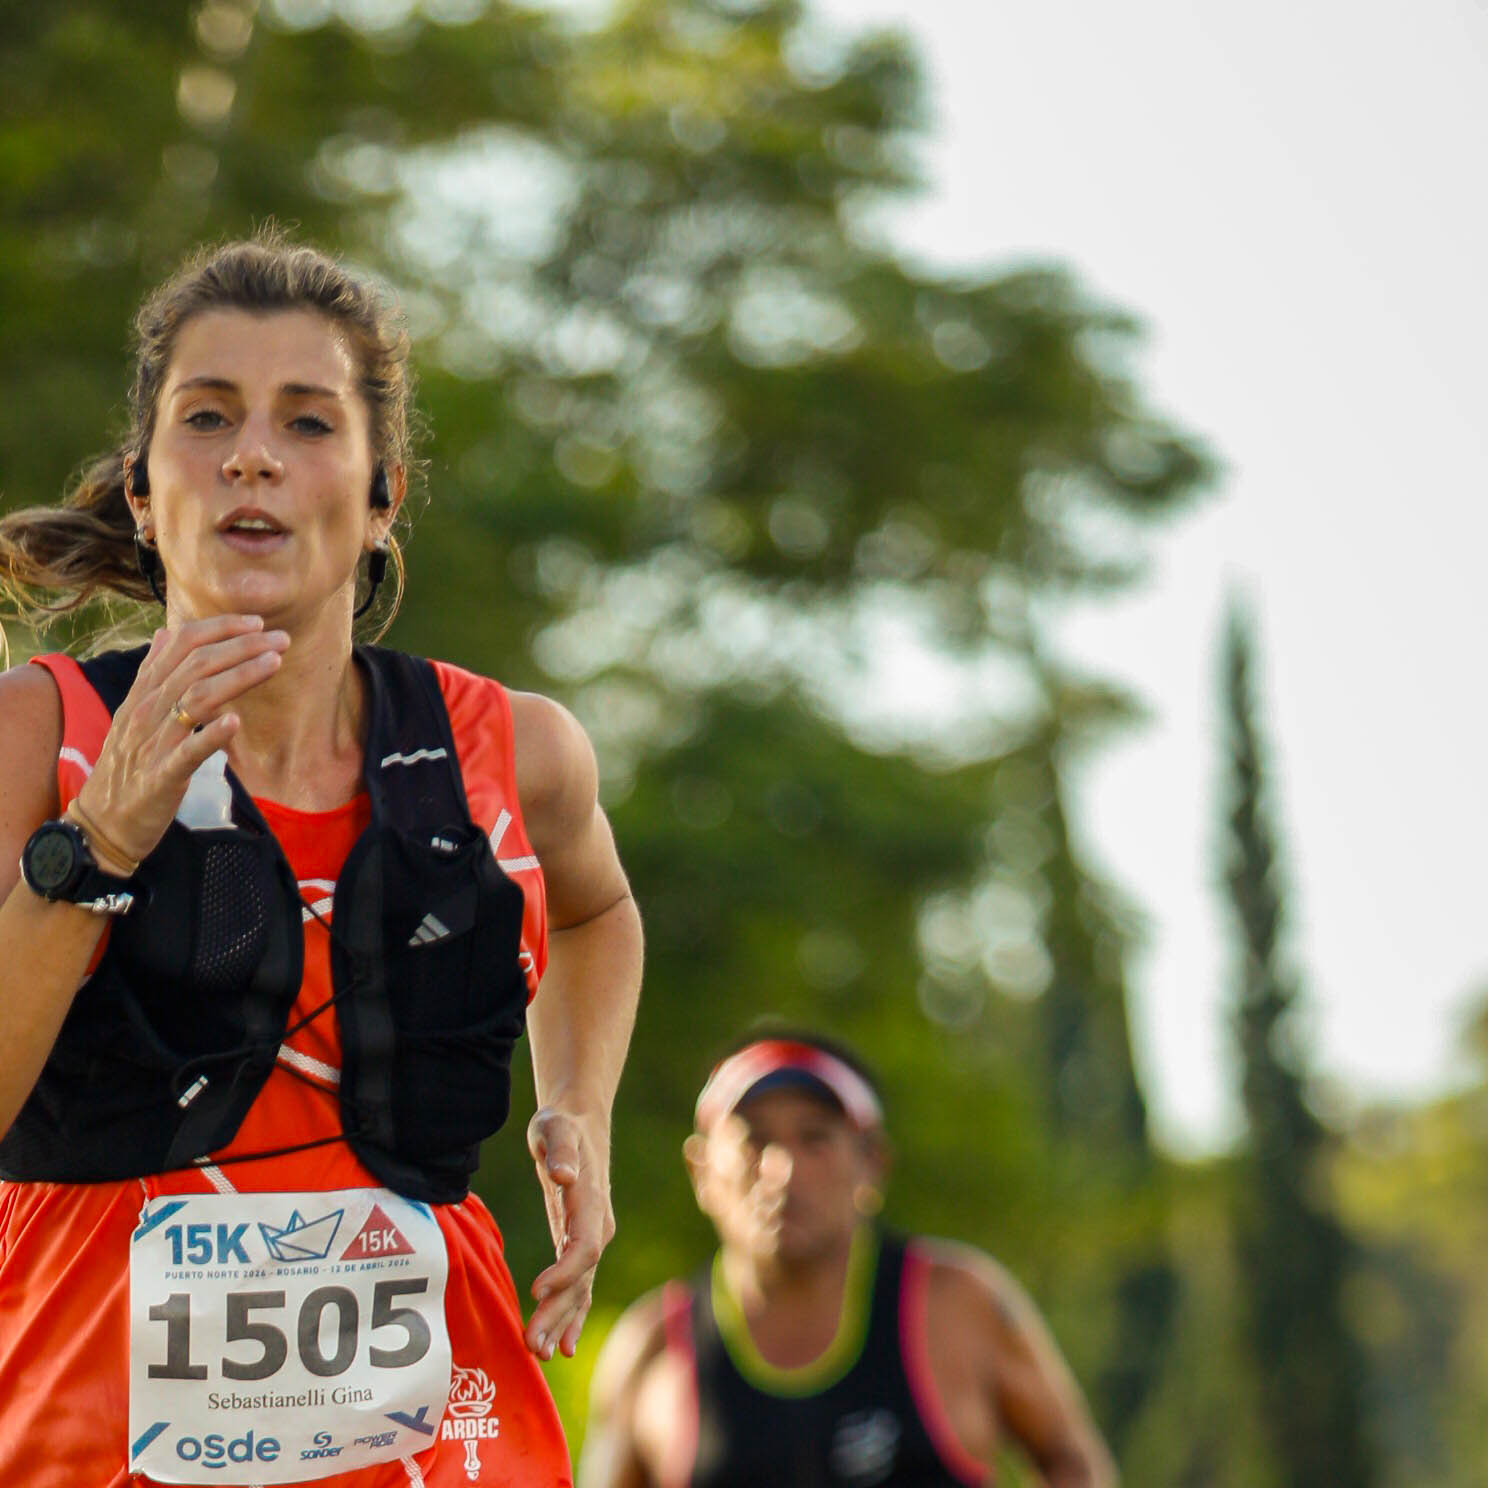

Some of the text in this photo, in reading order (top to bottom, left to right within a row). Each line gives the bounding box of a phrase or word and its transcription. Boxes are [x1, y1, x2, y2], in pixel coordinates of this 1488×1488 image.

[164, 1223, 252, 1264] 15K
[358, 1229, 398, 1253] 15K
[165, 1270, 204, 1279] PUERTO
[207, 1270, 239, 1279] NORTE
[276, 1266, 320, 1277] ROSARIO
[344, 1263, 356, 1272] DE
[359, 1261, 385, 1271] ABRIL
[388, 1258, 410, 1268] 2026
[148, 1277, 431, 1381] 1505
[207, 1384, 373, 1411] Sebastianelli Gina
[441, 1418, 499, 1441] ARDEC
[176, 1429, 281, 1464] osde
